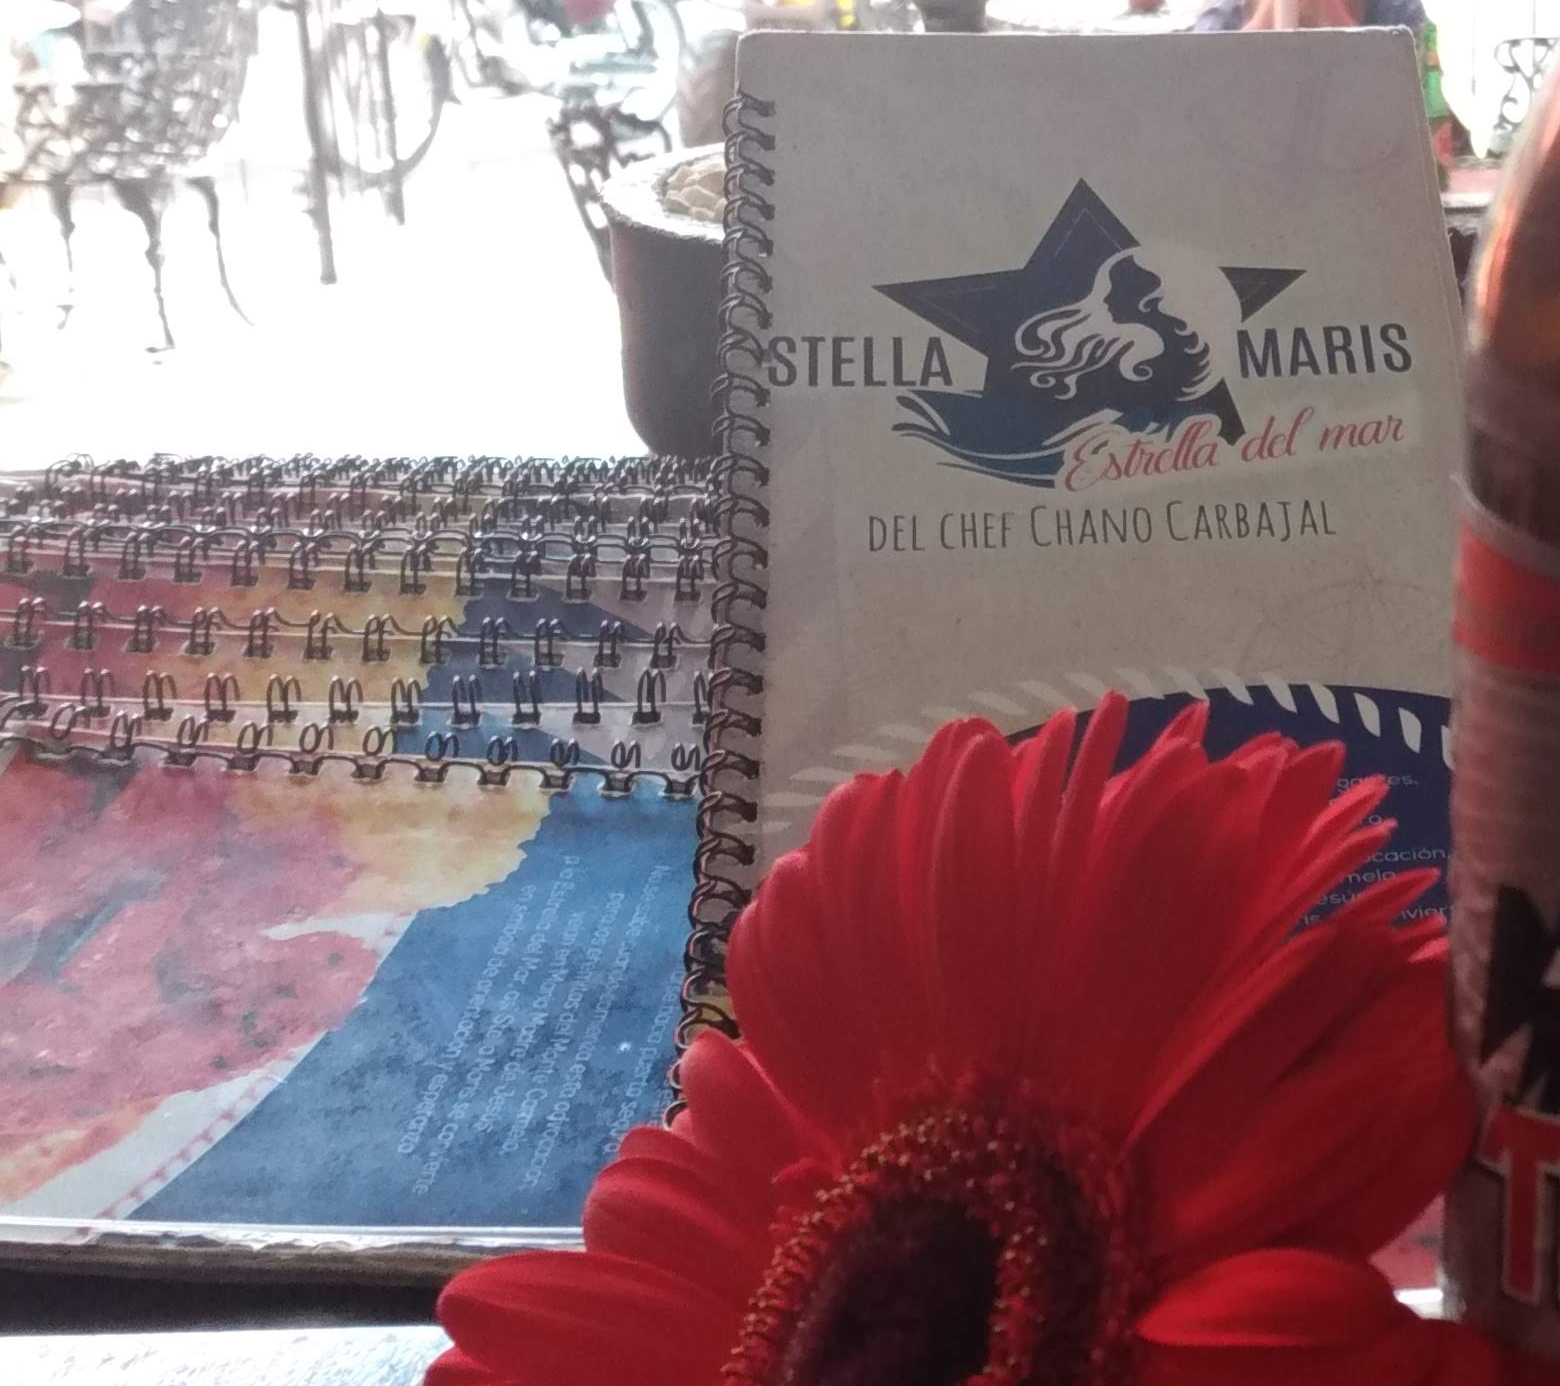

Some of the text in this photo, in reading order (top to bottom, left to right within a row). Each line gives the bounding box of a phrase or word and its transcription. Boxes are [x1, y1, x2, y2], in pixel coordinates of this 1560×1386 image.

[766, 322, 1413, 389] STELLA MARIS
[1063, 406, 1405, 494] Estrella del mar
[868, 498, 1337, 553] DEL CHEF CHANO CARBAJAL
